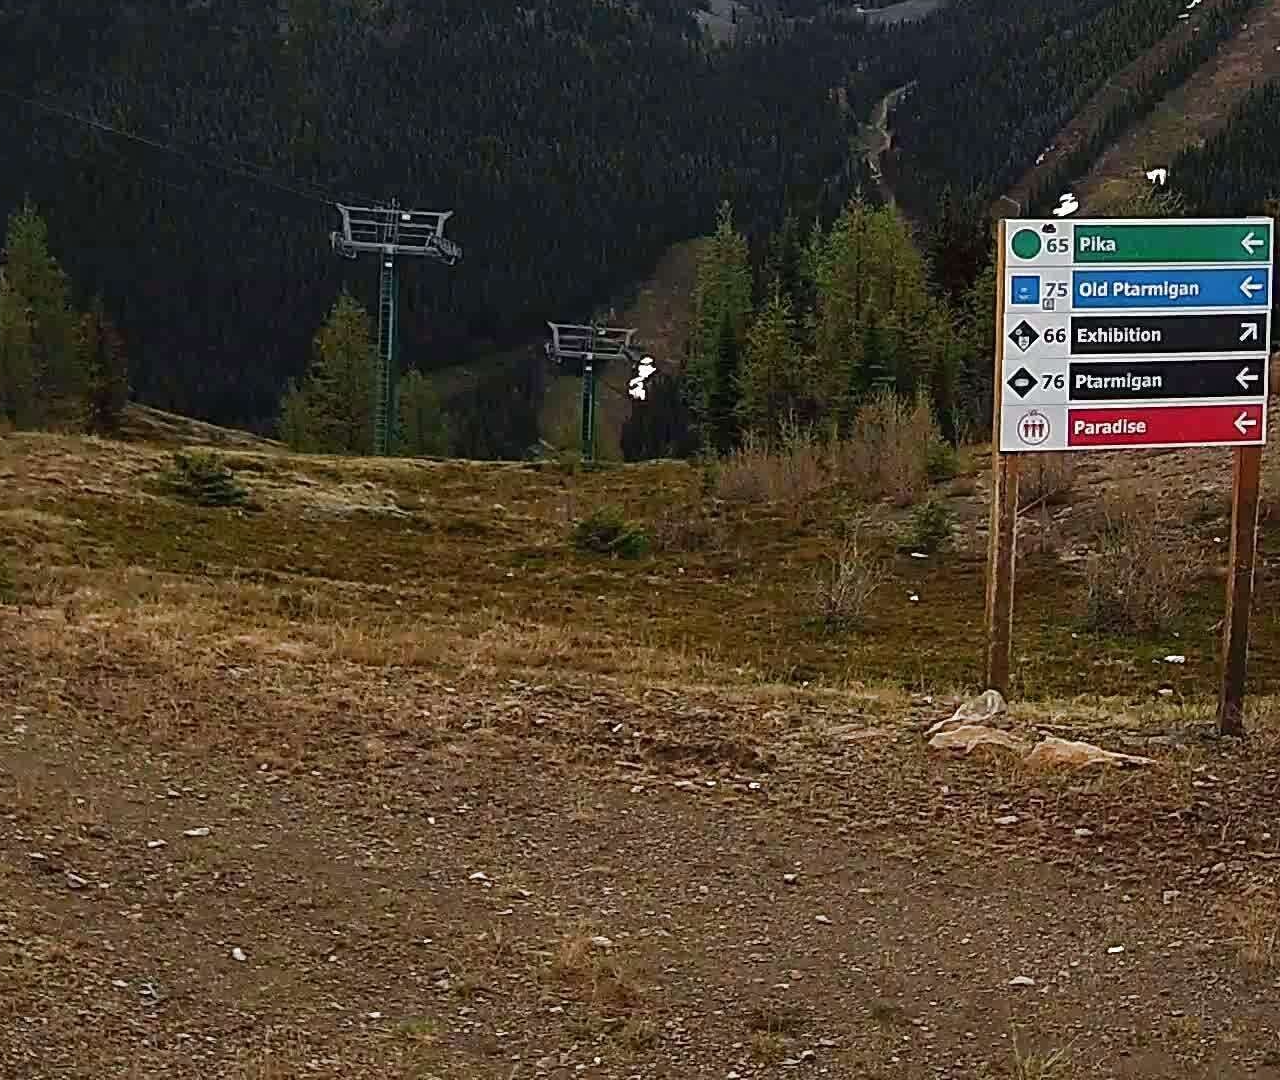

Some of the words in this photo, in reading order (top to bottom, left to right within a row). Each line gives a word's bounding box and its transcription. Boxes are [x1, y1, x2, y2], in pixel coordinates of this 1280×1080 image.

[1046, 238, 1069, 253] 65
[1080, 236, 1116, 252] Pika
[1045, 282, 1068, 298] 75
[1079, 280, 1108, 297] Old
[1113, 281, 1200, 299] Ptarmigan
[1043, 328, 1067, 343] 66
[1077, 326, 1161, 343] Exhibition
[1042, 374, 1065, 389] 76
[1075, 372, 1162, 390] Ptarmigan
[1073, 418, 1147, 434] Paradise
